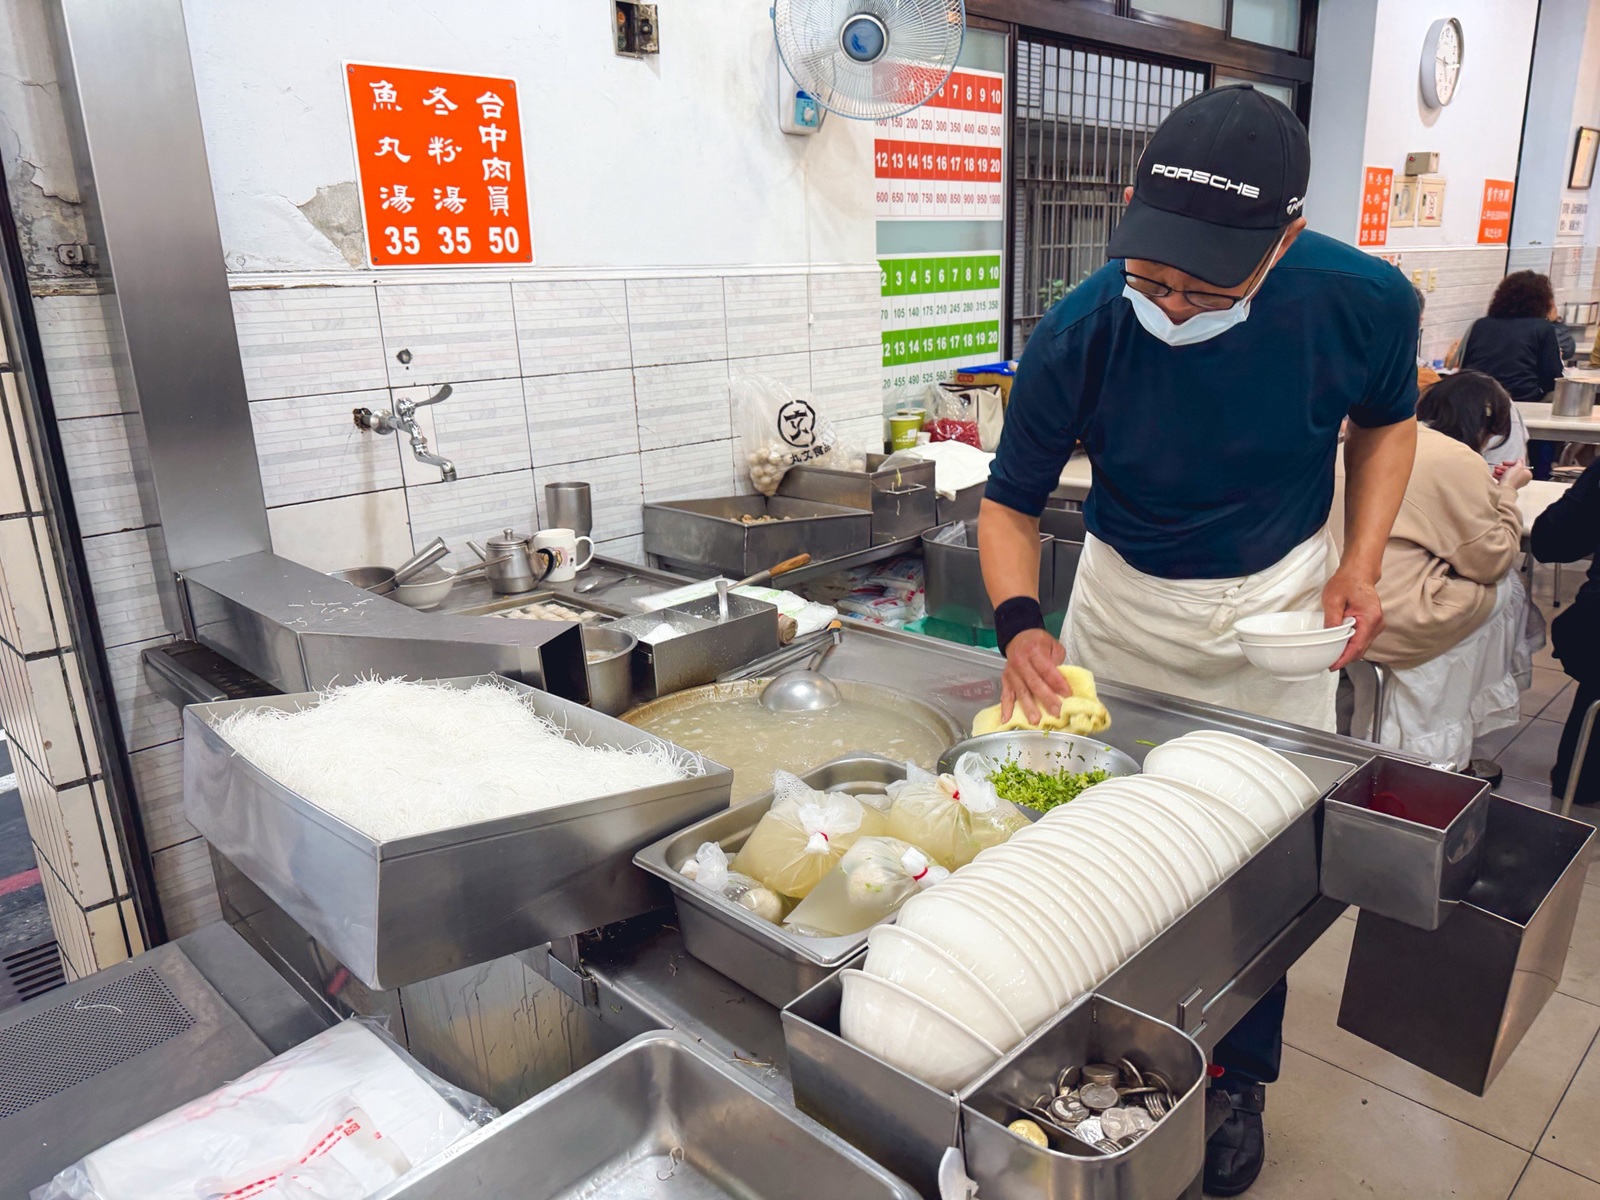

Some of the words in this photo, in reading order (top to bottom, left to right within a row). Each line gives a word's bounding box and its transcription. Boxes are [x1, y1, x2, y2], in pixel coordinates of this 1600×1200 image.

[952, 84, 959, 99] 7
[966, 86, 973, 100] 8
[979, 87, 986, 102] 9
[991, 90, 1001, 104] 10
[891, 117, 903, 128] 150
[906, 118, 918, 129] 200
[921, 119, 933, 130] 250
[936, 120, 947, 132] 300
[950, 121, 961, 133] 350
[964, 123, 974, 134] 400
[977, 125, 988, 135] 450
[990, 126, 1001, 136] 500
[369, 80, 415, 213] 魚丸湯
[422, 86, 467, 214] 冬粉湯
[476, 91, 511, 217] 台中肉員
[876, 152, 888, 167] 12
[892, 153, 903, 168] 13
[907, 154, 918, 169] 14
[922, 155, 933, 170] 15
[936, 156, 947, 171] 16
[950, 157, 961, 171] 17
[964, 157, 974, 172] 18
[977, 158, 988, 172] 19
[990, 159, 1000, 173] 20
[1151, 163, 1260, 199] PORSCHE
[876, 192, 888, 203] 600
[892, 192, 903, 203] 650
[907, 192, 918, 203] 700
[922, 193, 933, 203] 750
[936, 193, 947, 204] 800
[950, 193, 961, 204] 850
[963, 193, 974, 204] 900
[977, 194, 987, 204] 950
[384, 226, 421, 255] 35
[437, 226, 472, 254] 35
[488, 226, 520, 254] 50
[881, 272, 887, 286] 2
[896, 271, 902, 285] 3
[910, 270, 916, 284] 4
[925, 270, 931, 284] 5
[938, 269, 945, 283] 6
[952, 268, 958, 282] 7
[965, 267, 972, 281] 8
[978, 267, 984, 280] 9
[989, 266, 999, 280] 10
[894, 308, 905, 319] 105
[908, 307, 919, 317] 140
[922, 305, 933, 316] 175
[936, 304, 947, 315] 210
[950, 303, 960, 314] 245
[963, 302, 973, 312] 280
[976, 301, 986, 311] 315
[988, 300, 998, 310] 350
[894, 341, 905, 355] 13
[908, 340, 919, 354] 14
[922, 338, 933, 352] 15
[936, 337, 947, 350] 16
[950, 335, 960, 349] 17
[963, 334, 973, 347] 18
[976, 332, 986, 345] 19
[988, 331, 998, 344] 20
[883, 379, 891, 389] 20
[894, 376, 905, 387] 455
[908, 375, 919, 385] 490
[922, 373, 933, 383] 525
[936, 371, 947, 382] 560
